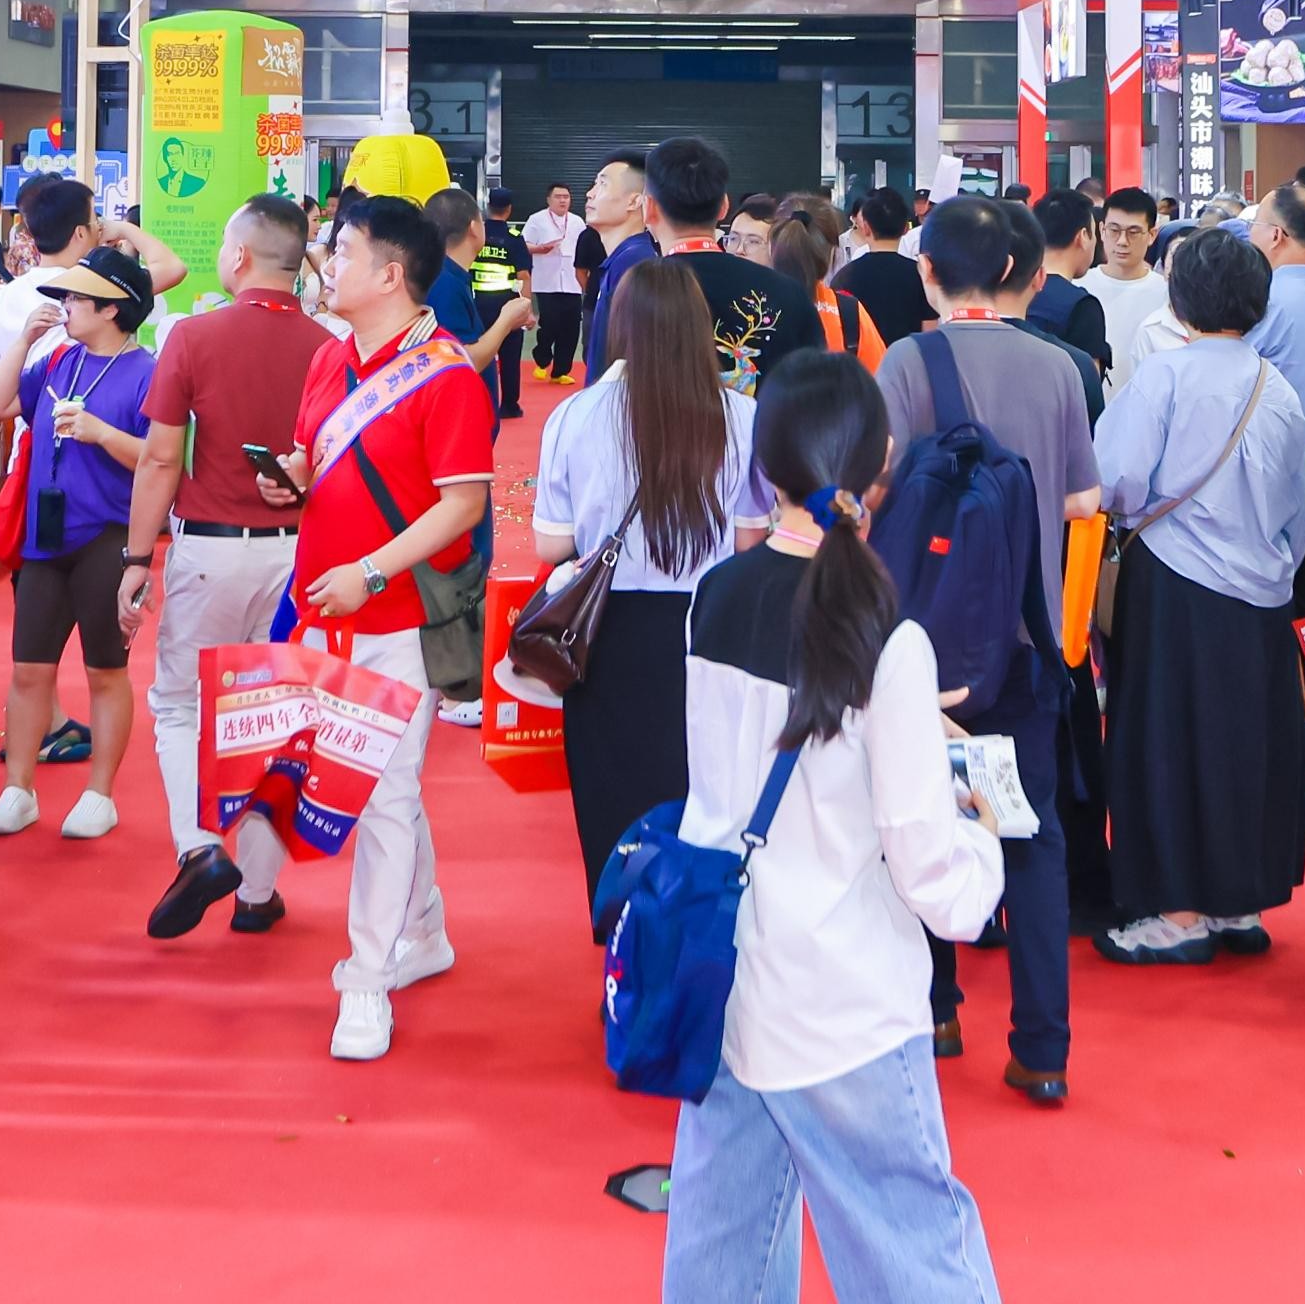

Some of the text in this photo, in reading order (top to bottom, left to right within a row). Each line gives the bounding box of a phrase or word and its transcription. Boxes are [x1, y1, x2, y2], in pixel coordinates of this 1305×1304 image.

[155, 43, 219, 60] 杀菌率达
[154, 59, 218, 77] 99.99%
[478, 246, 507, 260] 保卫士
